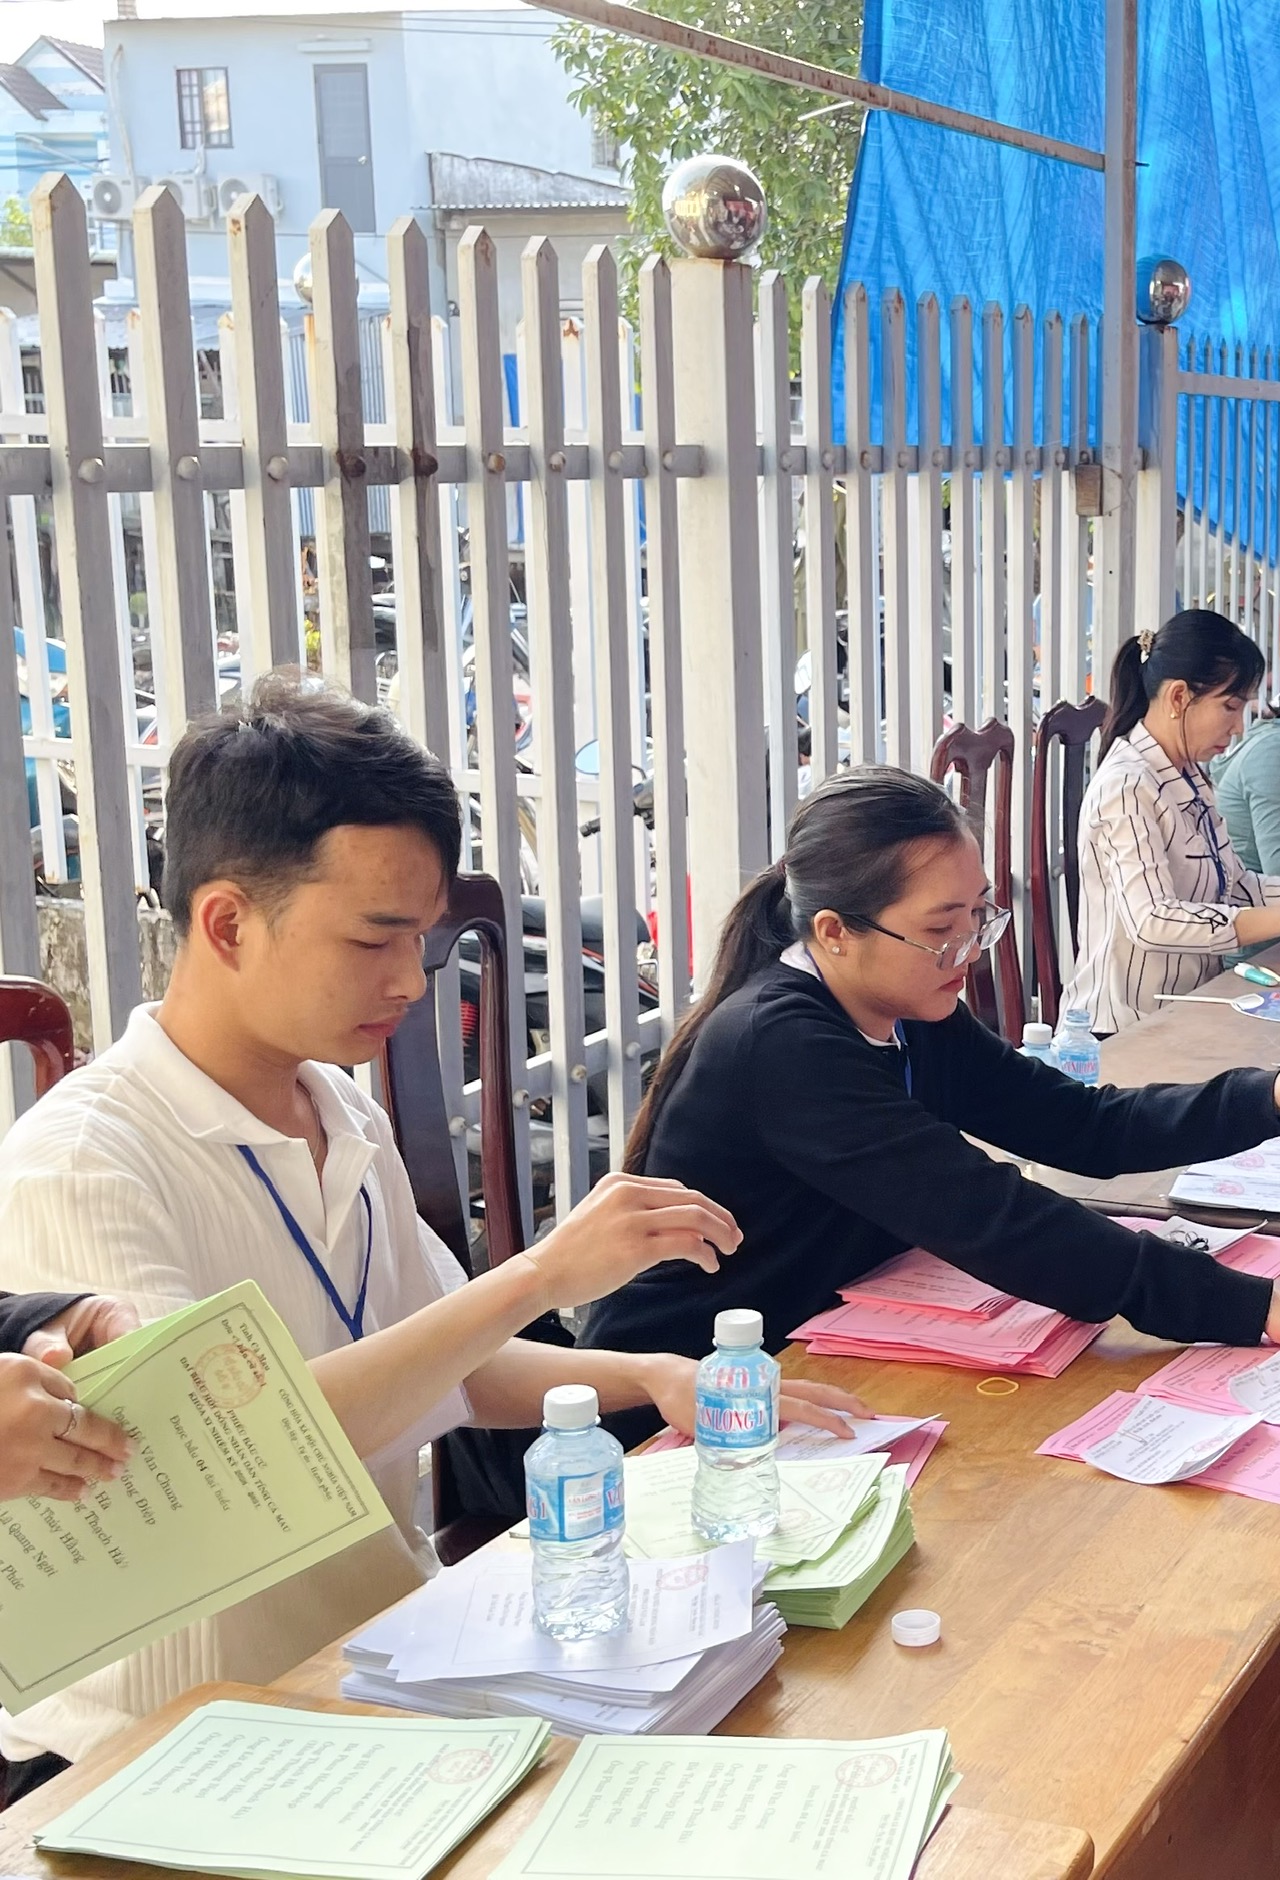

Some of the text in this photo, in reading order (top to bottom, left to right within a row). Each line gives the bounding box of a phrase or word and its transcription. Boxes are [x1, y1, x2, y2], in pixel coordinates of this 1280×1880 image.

[714, 1407, 754, 1432] LONG
[153, 1469, 185, 1512] Chung
[5, 1520, 37, 1556] Quang
